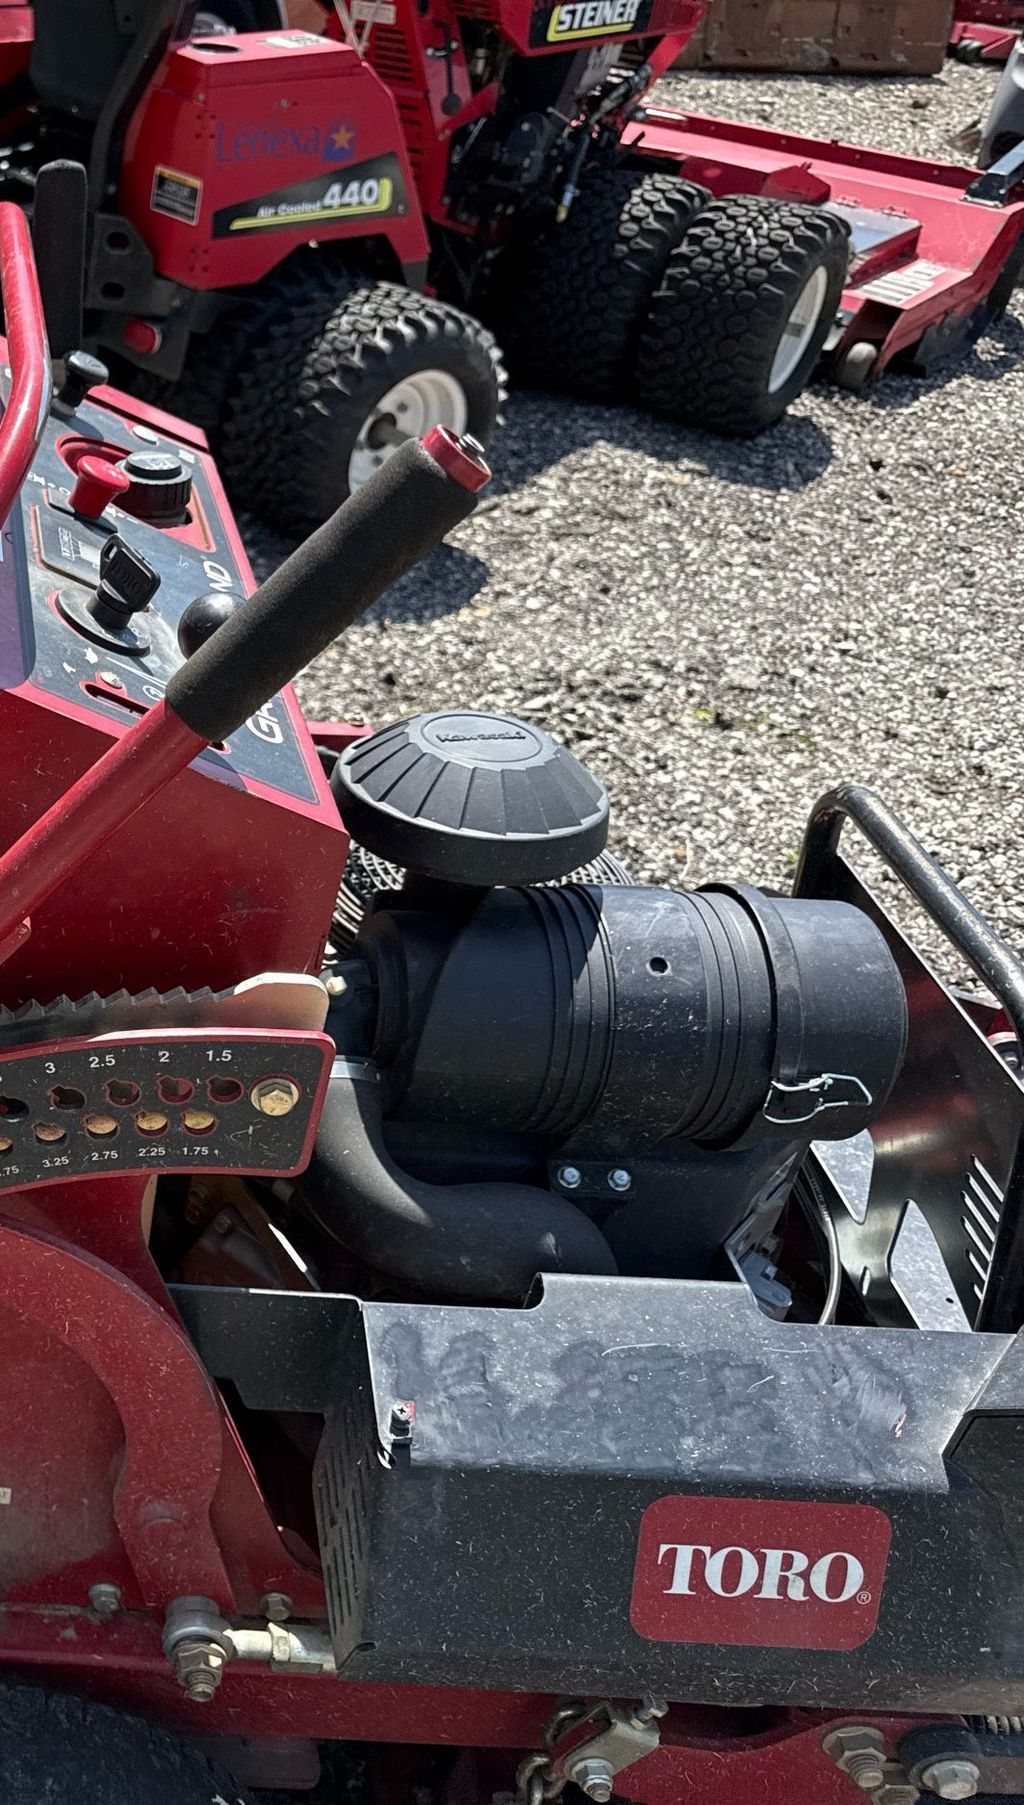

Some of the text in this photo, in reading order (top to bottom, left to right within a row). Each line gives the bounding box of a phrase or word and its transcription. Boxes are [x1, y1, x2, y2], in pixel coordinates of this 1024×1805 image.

[556, 0, 640, 31] STEINER
[256, 206, 277, 219] Air
[322, 178, 379, 208] 440
[45, 1062, 56, 1074] 3
[89, 1054, 116, 1068] 2.5
[159, 1051, 170, 1063] 2
[206, 1049, 232, 1063] 1.5
[42, 1156, 69, 1168] 3.25
[91, 1150, 118, 1161] 2.75
[138, 1147, 166, 1157] 2.25
[182, 1146, 209, 1156] 1.75
